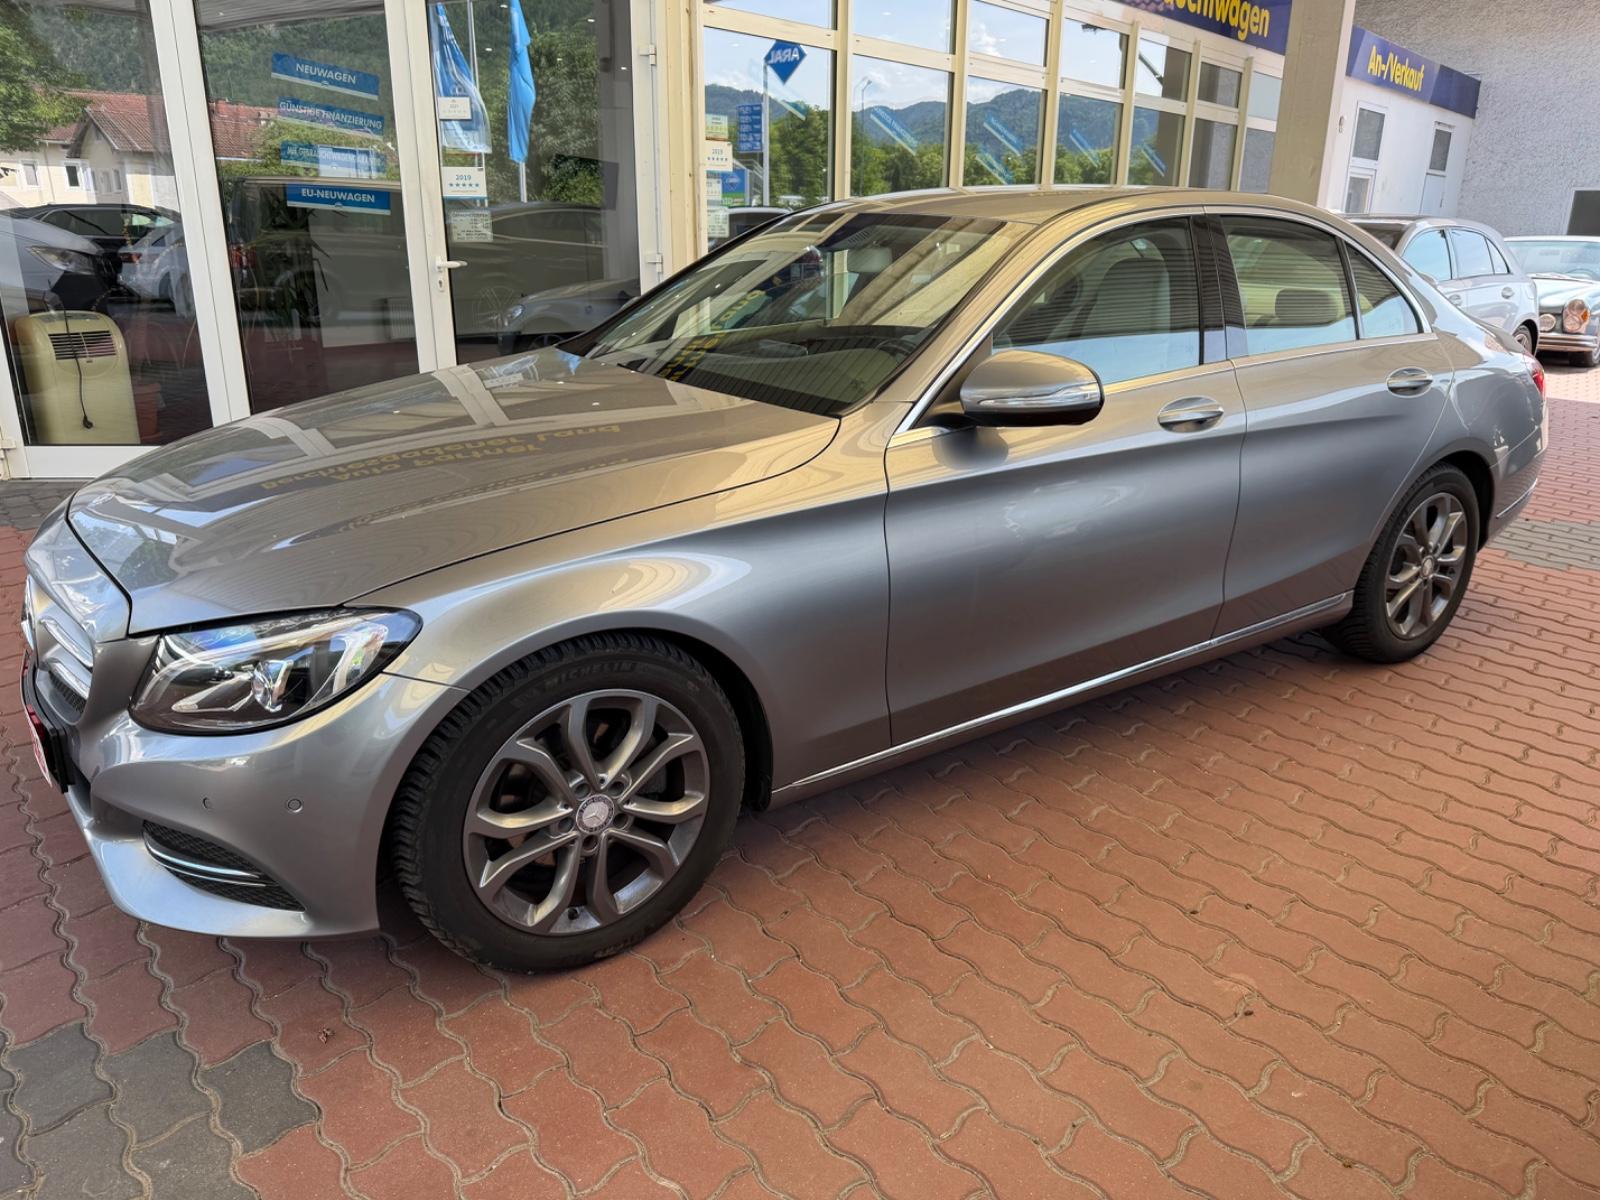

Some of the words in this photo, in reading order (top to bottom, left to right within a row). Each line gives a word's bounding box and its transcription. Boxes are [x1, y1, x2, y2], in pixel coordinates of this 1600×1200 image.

[295, 63, 357, 85] NEUWAGEN
[1367, 45, 1425, 92] An-/Verkauf
[301, 187, 375, 203] EU-NEUWAGEN
